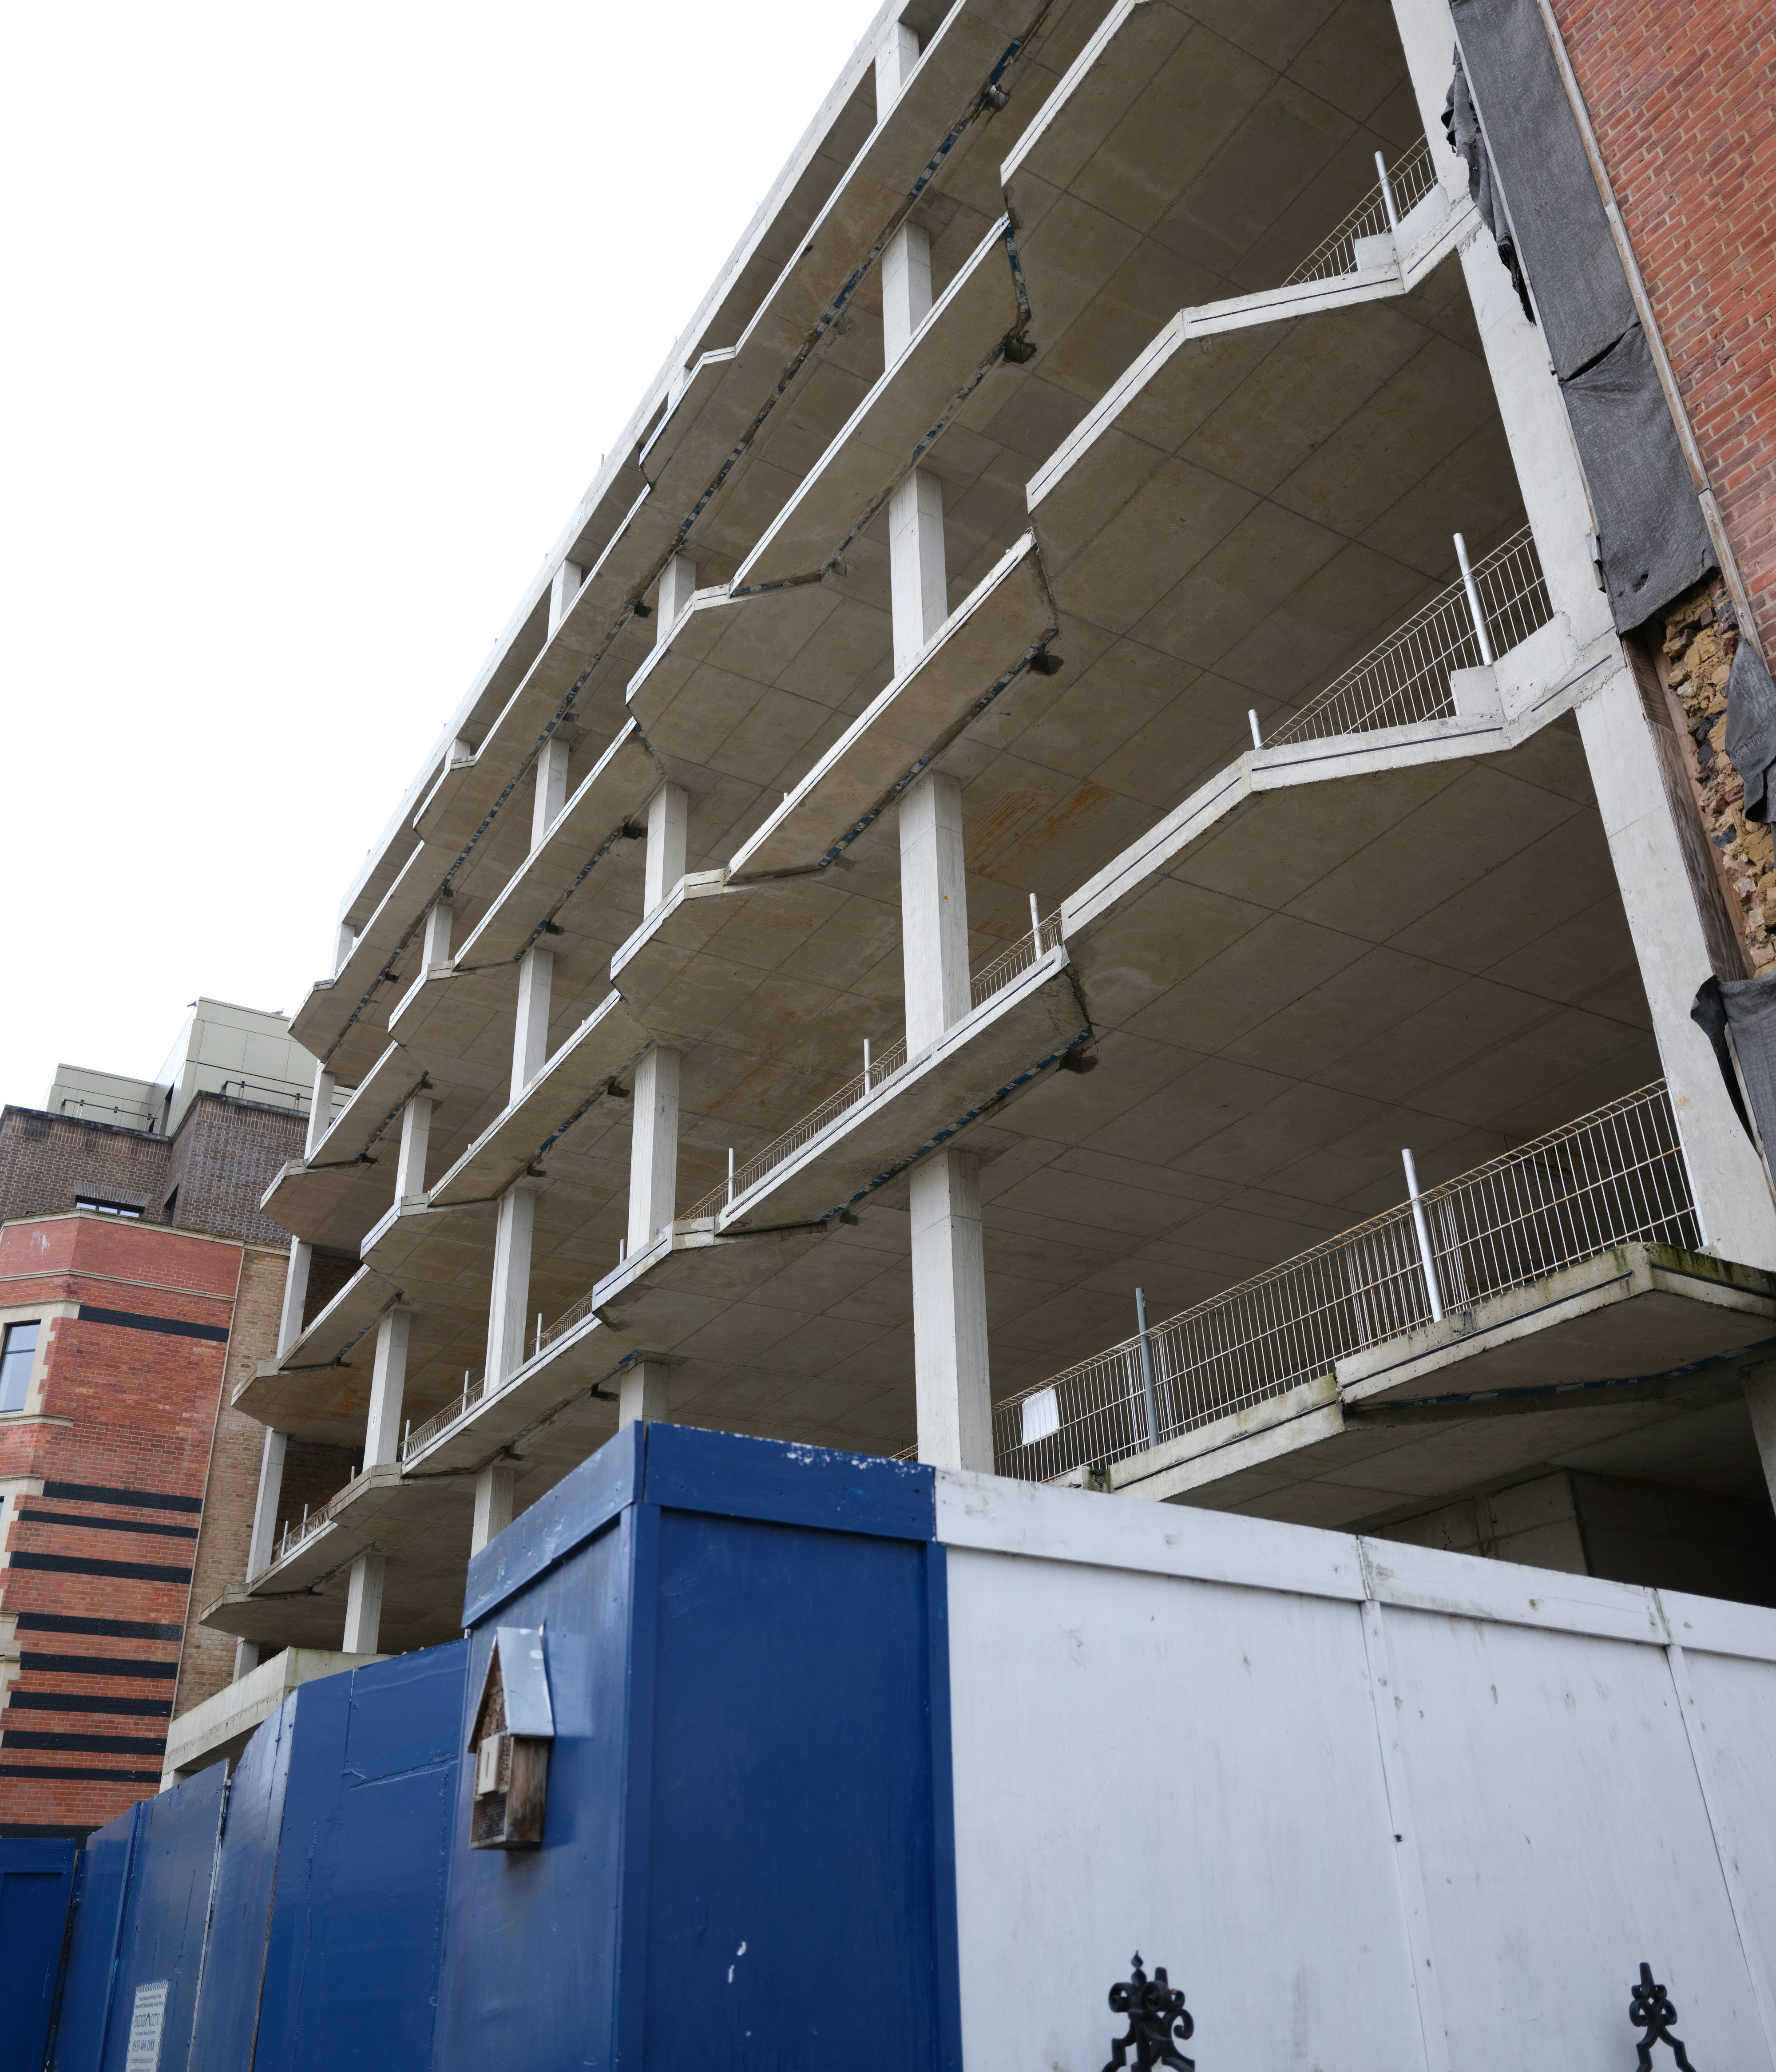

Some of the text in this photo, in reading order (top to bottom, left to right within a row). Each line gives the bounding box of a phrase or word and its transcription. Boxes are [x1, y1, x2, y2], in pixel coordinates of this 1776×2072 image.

[134, 2013, 160, 2028] BRIDGE CCTV
[147, 2039, 155, 2051] 1888
